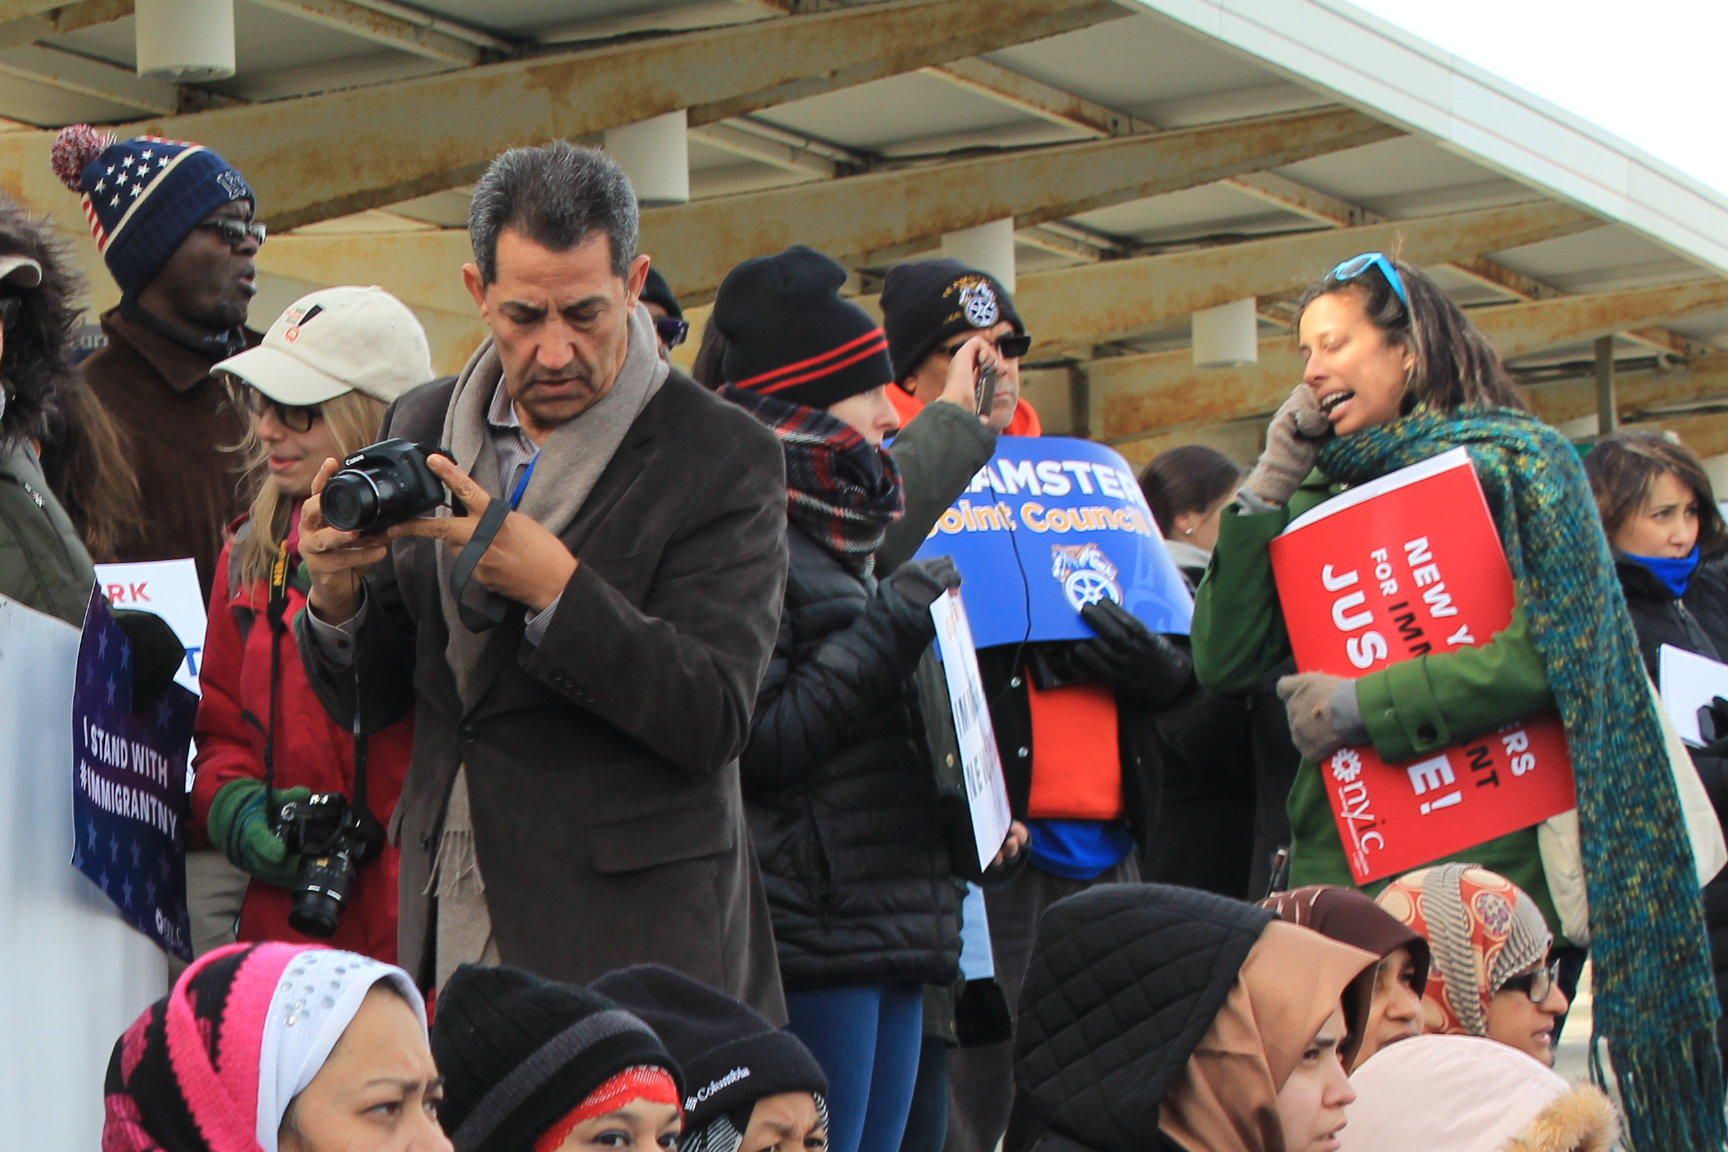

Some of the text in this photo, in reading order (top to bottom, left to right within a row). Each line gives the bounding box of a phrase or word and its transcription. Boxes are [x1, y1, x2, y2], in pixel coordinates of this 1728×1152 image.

[1369, 546, 1400, 599] FOR
[1403, 535, 1459, 621] NEW
[90, 731, 130, 771] STAND
[130, 740, 169, 790] WITH
[78, 759, 178, 842] #IMMIGRANTNY
